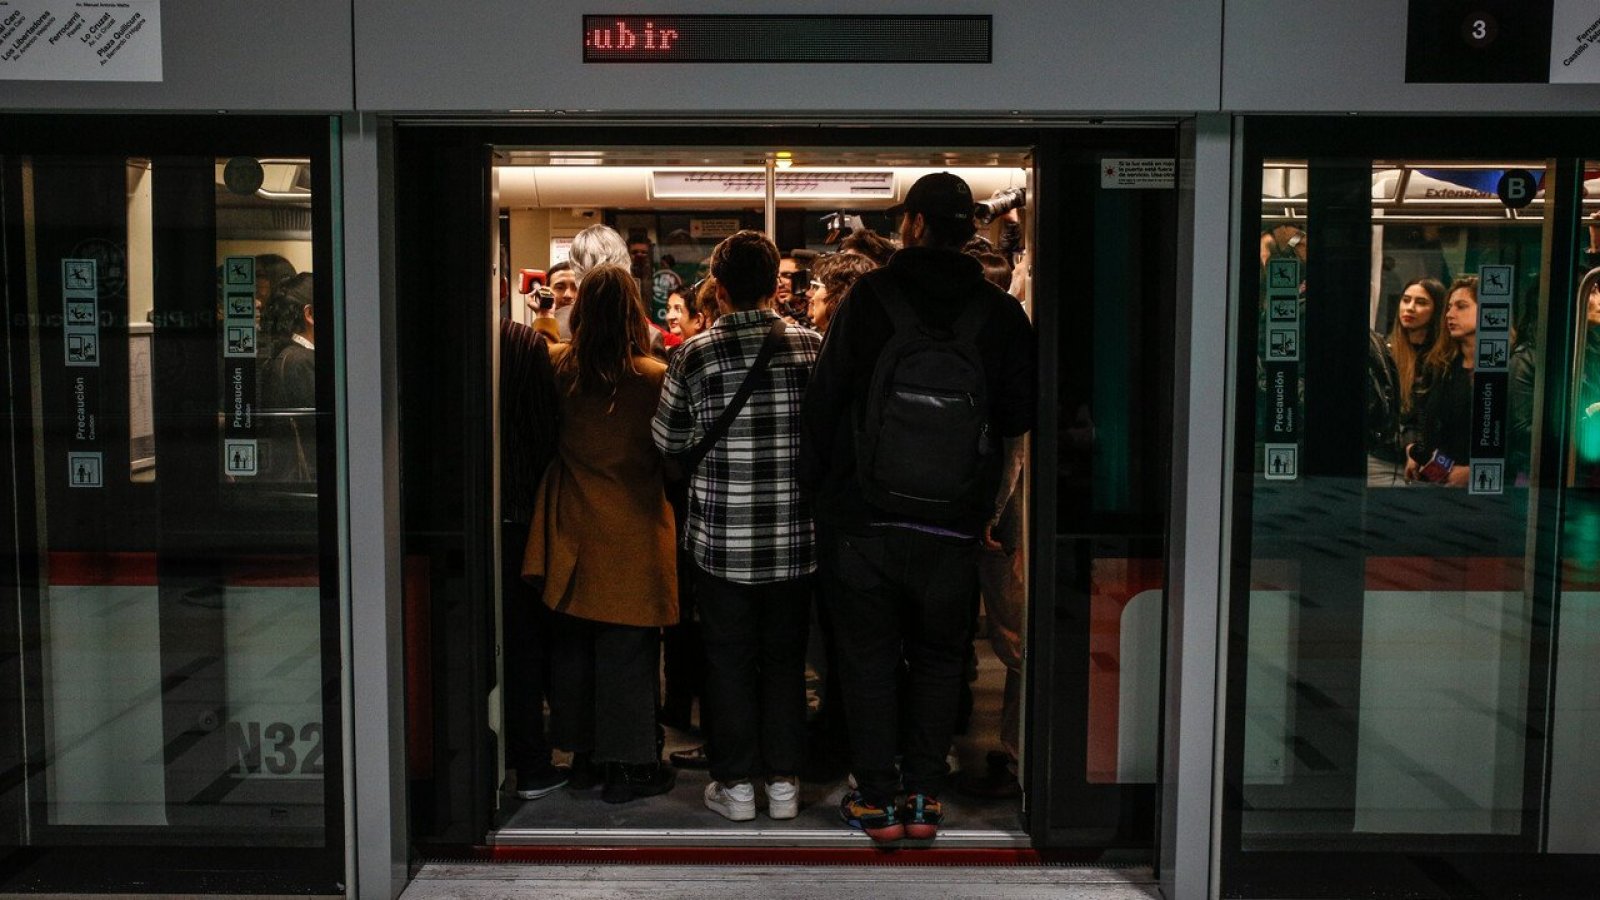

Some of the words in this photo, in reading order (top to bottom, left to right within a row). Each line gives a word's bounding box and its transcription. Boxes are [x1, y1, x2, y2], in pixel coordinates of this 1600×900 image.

[4, 10, 20, 25] Caro
[48, 11, 80, 45] Ferrocarril
[80, 33, 91, 43] Lo
[89, 12, 111, 34] Cruzat
[1472, 20, 1486, 39] 3
[1576, 17, 1600, 43] Fernan
[1, 48, 15, 60] Los
[12, 10, 50, 49] Libertadores
[97, 39, 115, 56] Plaza
[113, 12, 141, 40] Quilicura
[586, 22, 679, 49] ubir
[1563, 43, 1588, 66] Castillo
[1508, 178, 1526, 199] B
[75, 377, 85, 440] Precaución
[233, 367, 242, 428] Precaución
[1274, 371, 1284, 432] Precaución
[1480, 383, 1492, 447] Precaución
